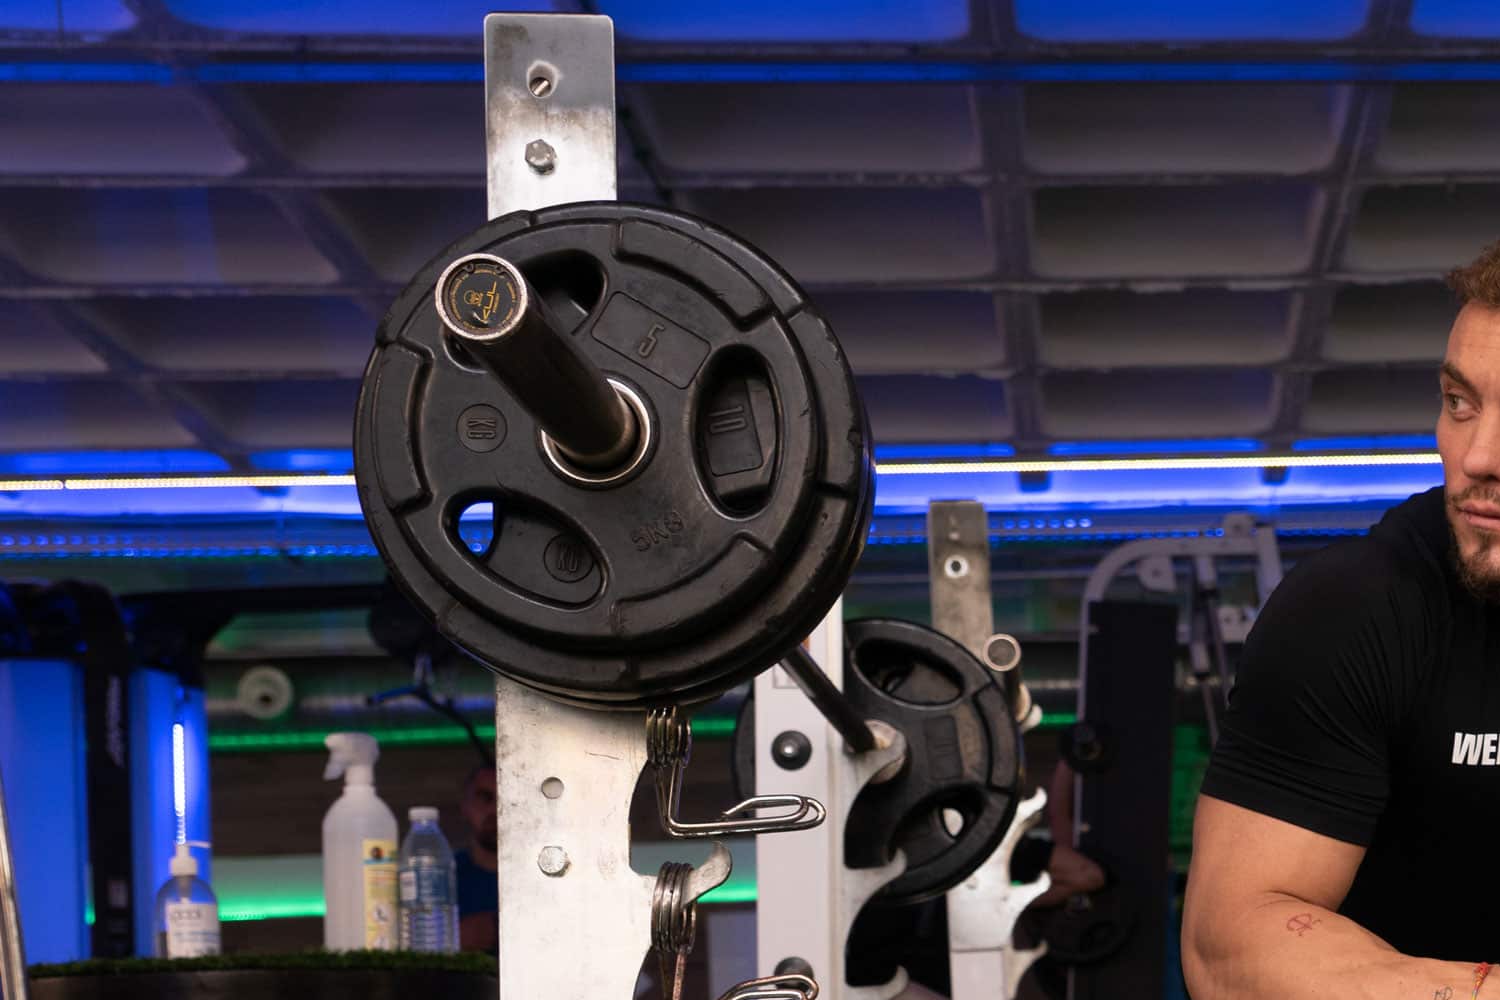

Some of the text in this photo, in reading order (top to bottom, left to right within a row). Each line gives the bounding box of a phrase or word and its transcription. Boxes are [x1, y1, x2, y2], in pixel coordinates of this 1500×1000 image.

[638, 321, 665, 358] 5
[467, 416, 498, 441] KG
[708, 404, 749, 435] 10
